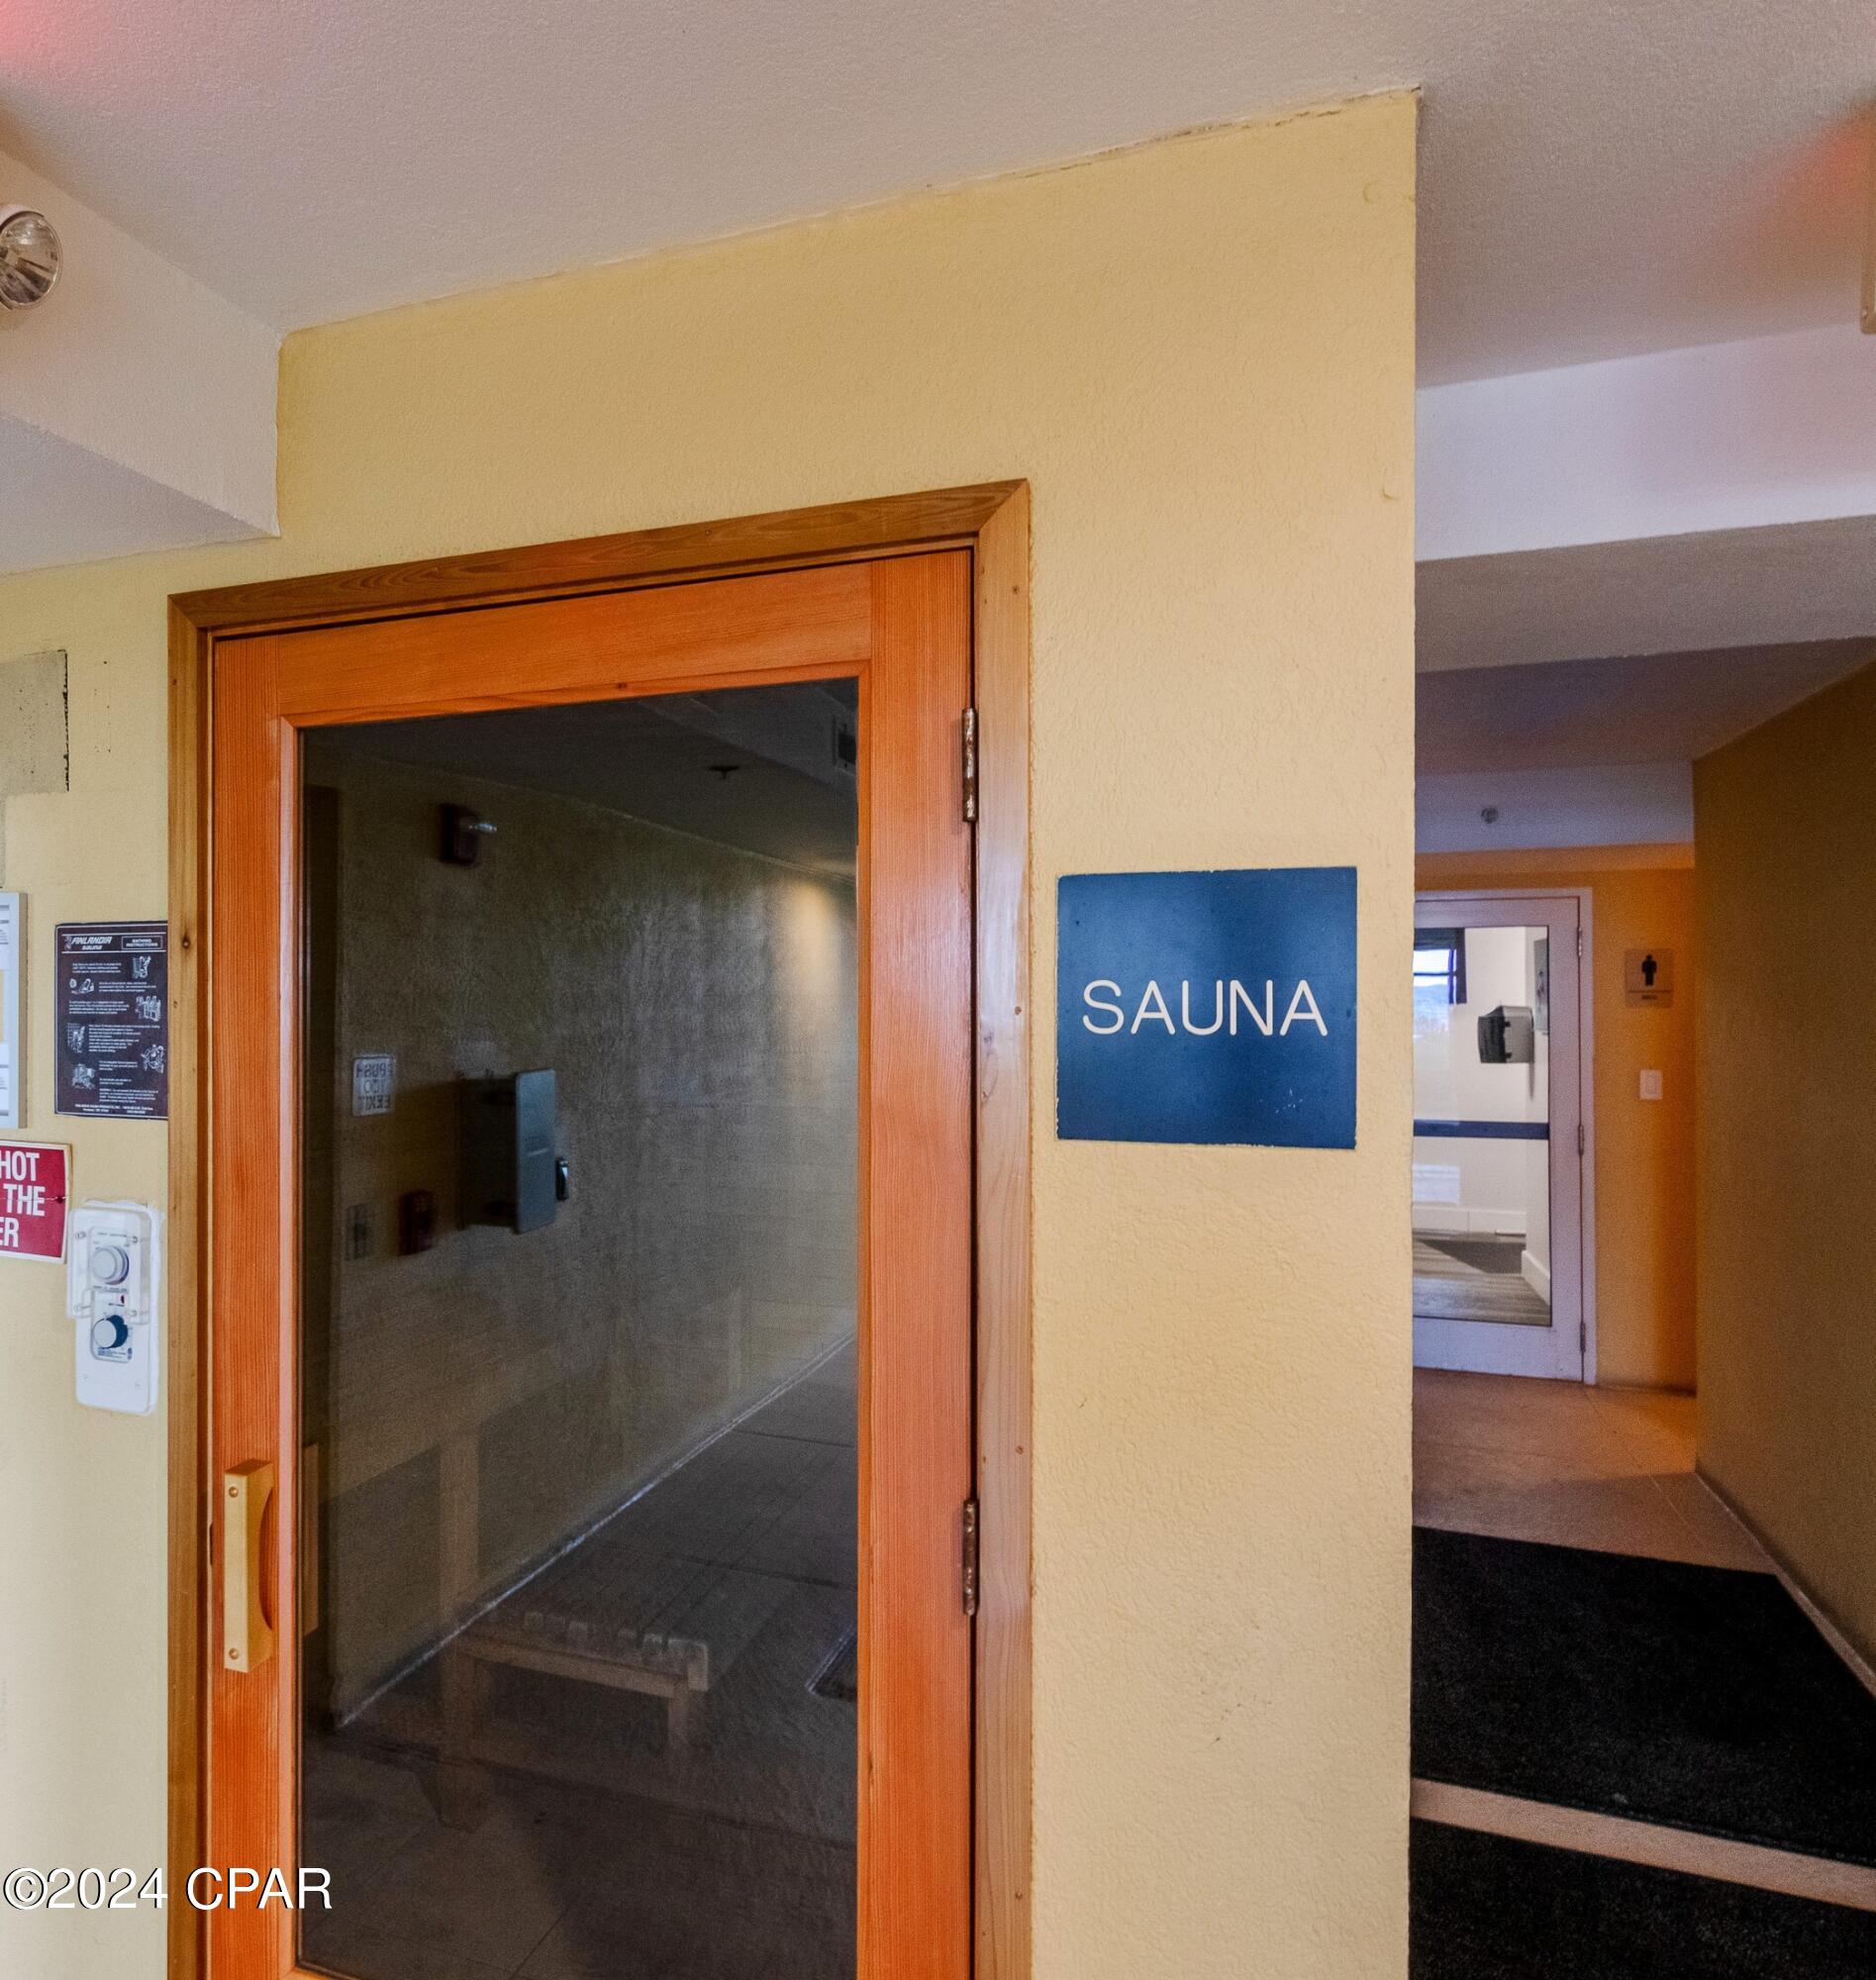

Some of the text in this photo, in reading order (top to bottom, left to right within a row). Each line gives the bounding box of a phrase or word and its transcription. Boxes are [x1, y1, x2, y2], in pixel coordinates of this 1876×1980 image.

[1082, 979, 1329, 1037] SAUNA
[0, 1149, 40, 1182] HOT
[3, 1183, 46, 1217] THE
